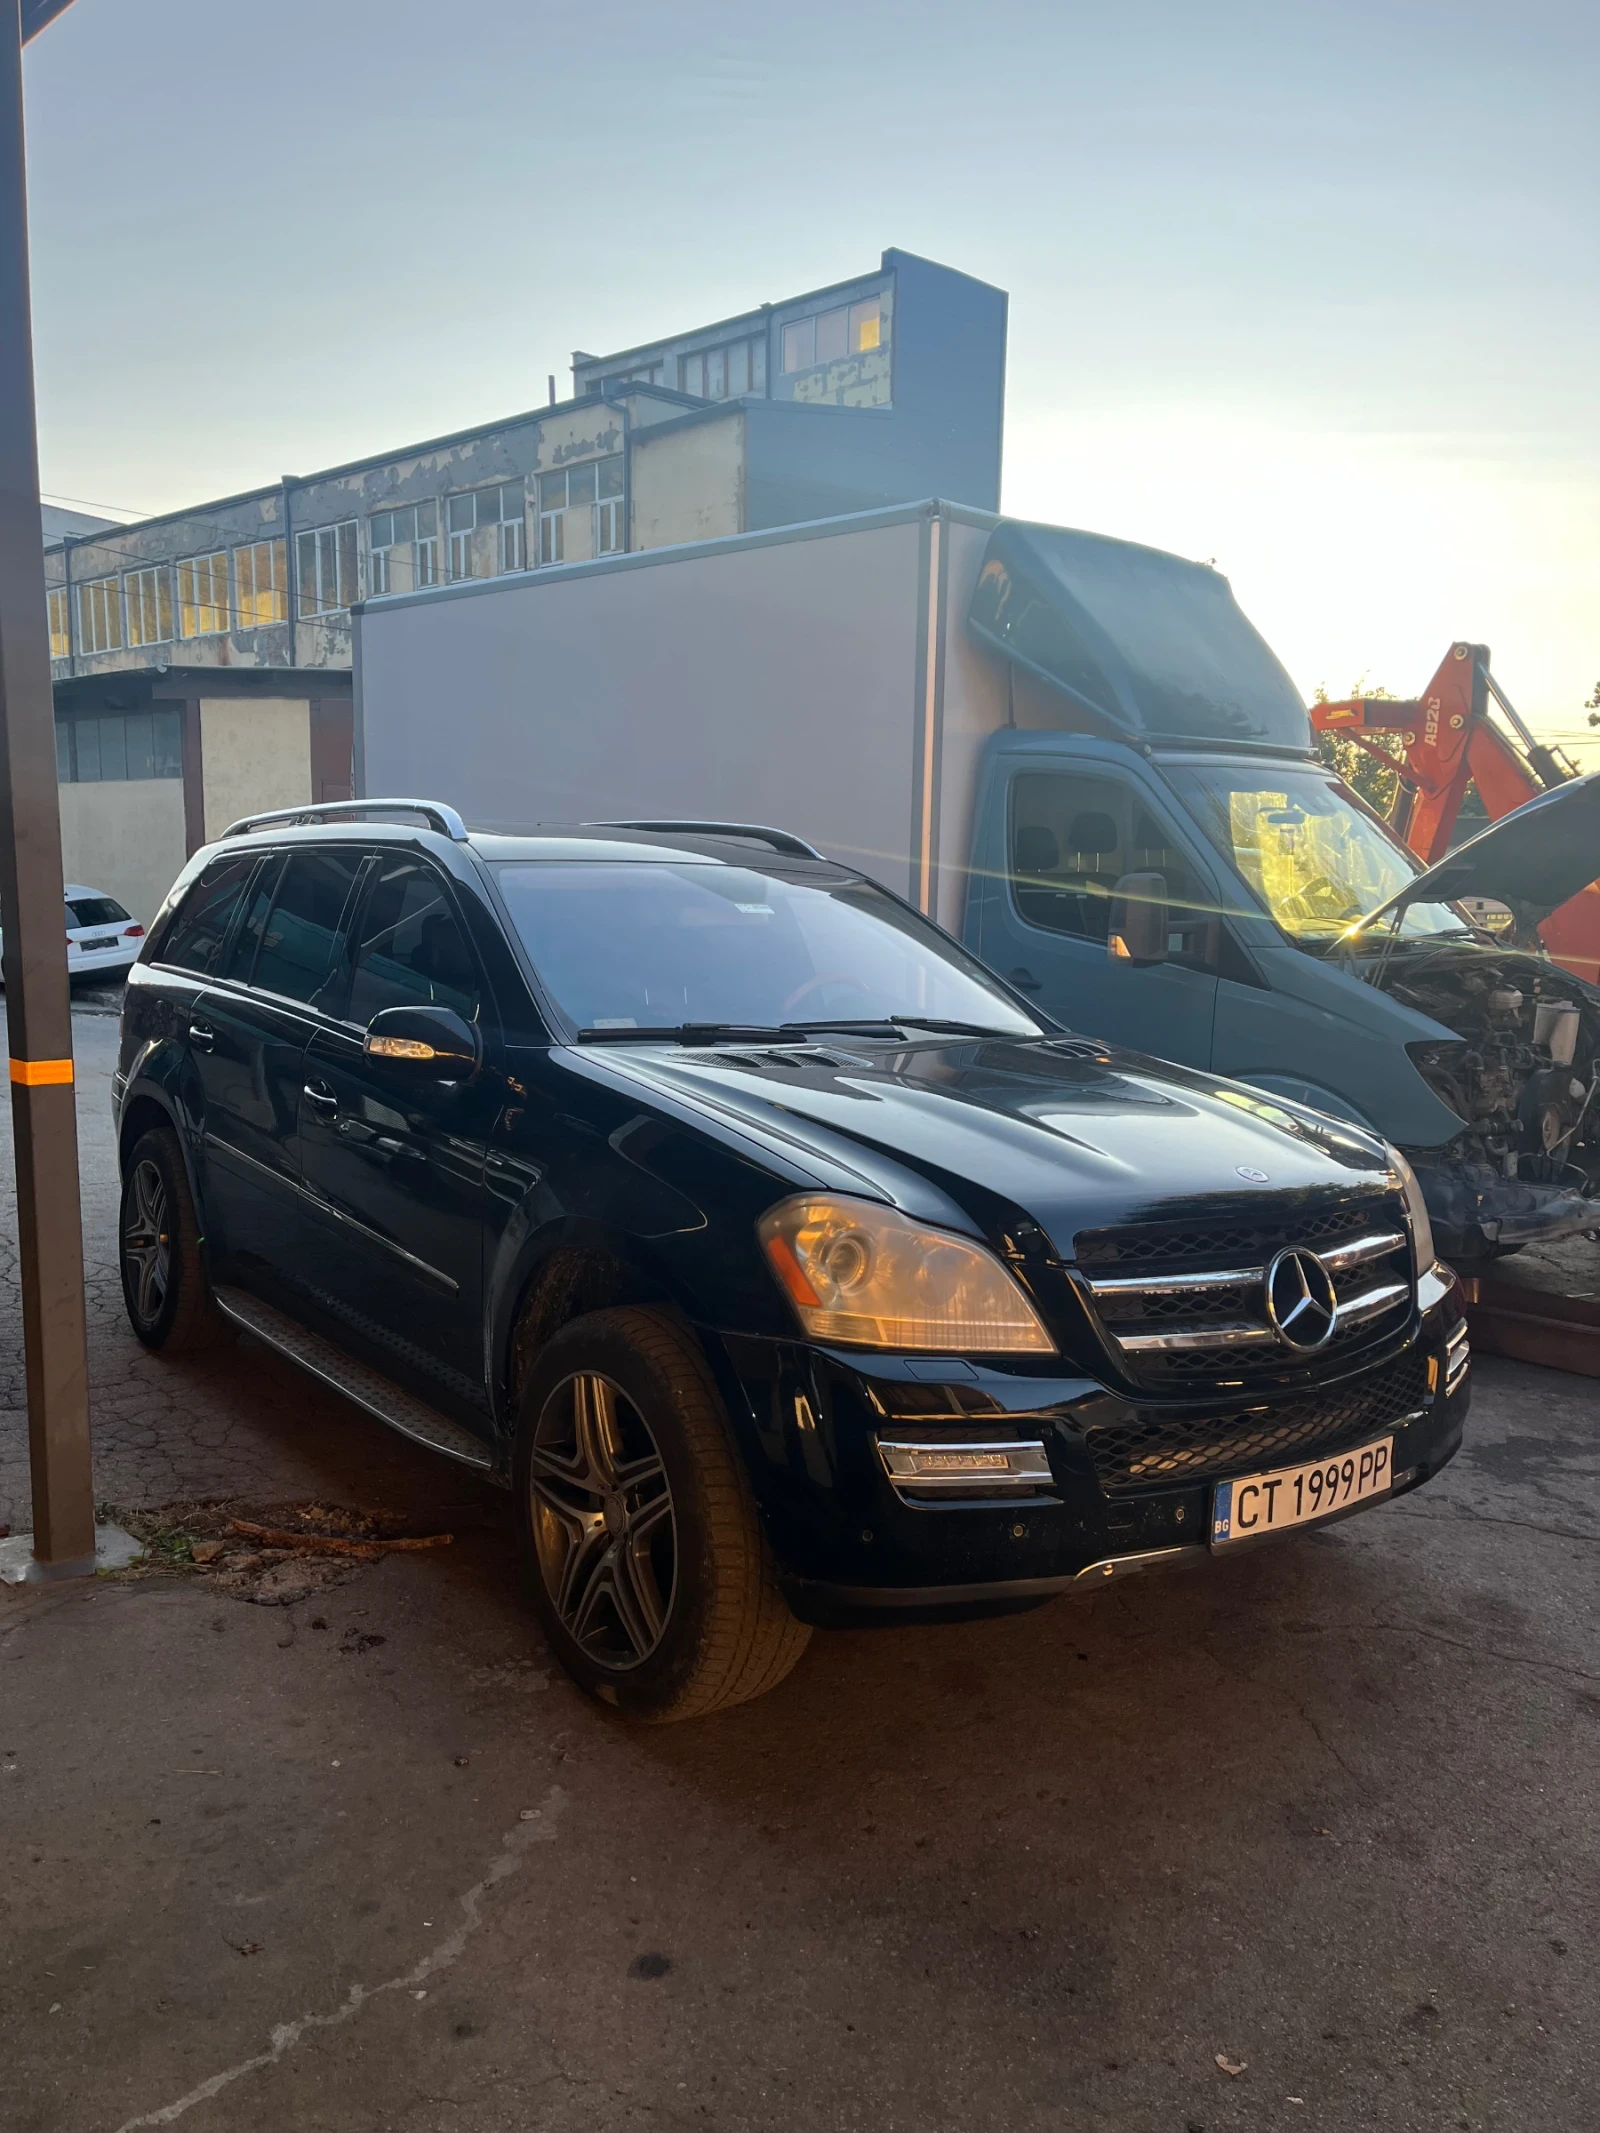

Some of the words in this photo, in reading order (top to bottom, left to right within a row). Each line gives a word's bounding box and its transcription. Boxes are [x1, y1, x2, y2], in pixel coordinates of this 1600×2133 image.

[1237, 1478, 1282, 1529] CT
[1293, 1458, 1355, 1517] 1999
[1357, 1445, 1388, 1494] PP
[1214, 1519, 1229, 1534] BG
